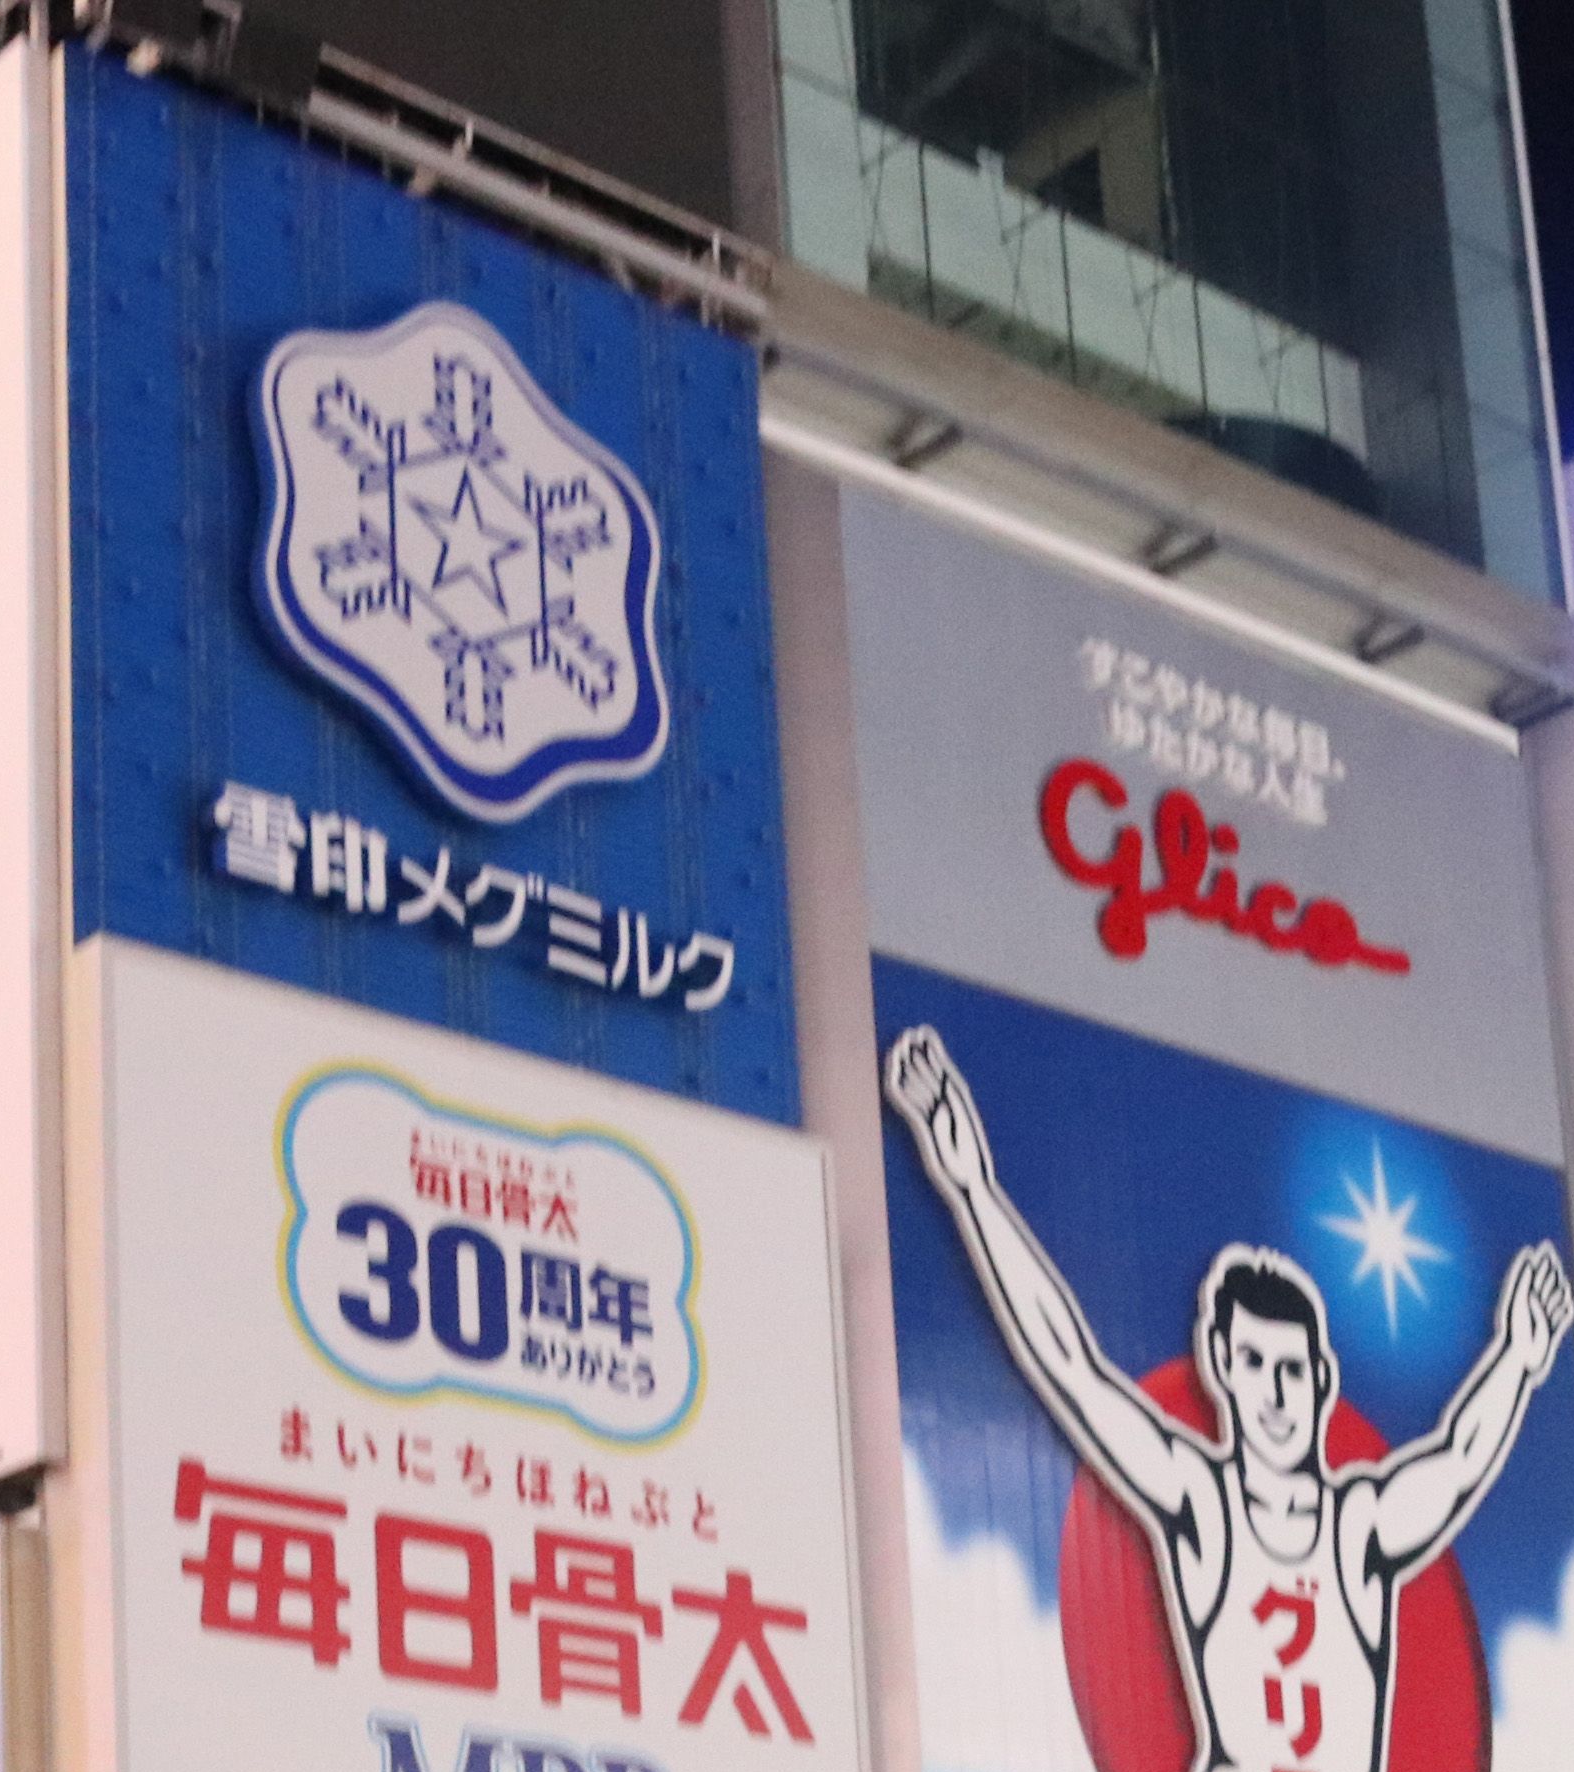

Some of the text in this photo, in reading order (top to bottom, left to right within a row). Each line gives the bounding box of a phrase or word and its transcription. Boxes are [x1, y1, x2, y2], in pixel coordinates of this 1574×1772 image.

[213, 779, 735, 1012] 雪印メグミルク
[1037, 757, 1412, 977] Glico
[409, 1152, 580, 1245] 毎日骨太
[334, 1199, 655, 1364] 30周年
[521, 1332, 656, 1400] ありがとう
[277, 1404, 719, 1542] まいにちほねぶと
[173, 1456, 816, 1747] 毎日骨太
